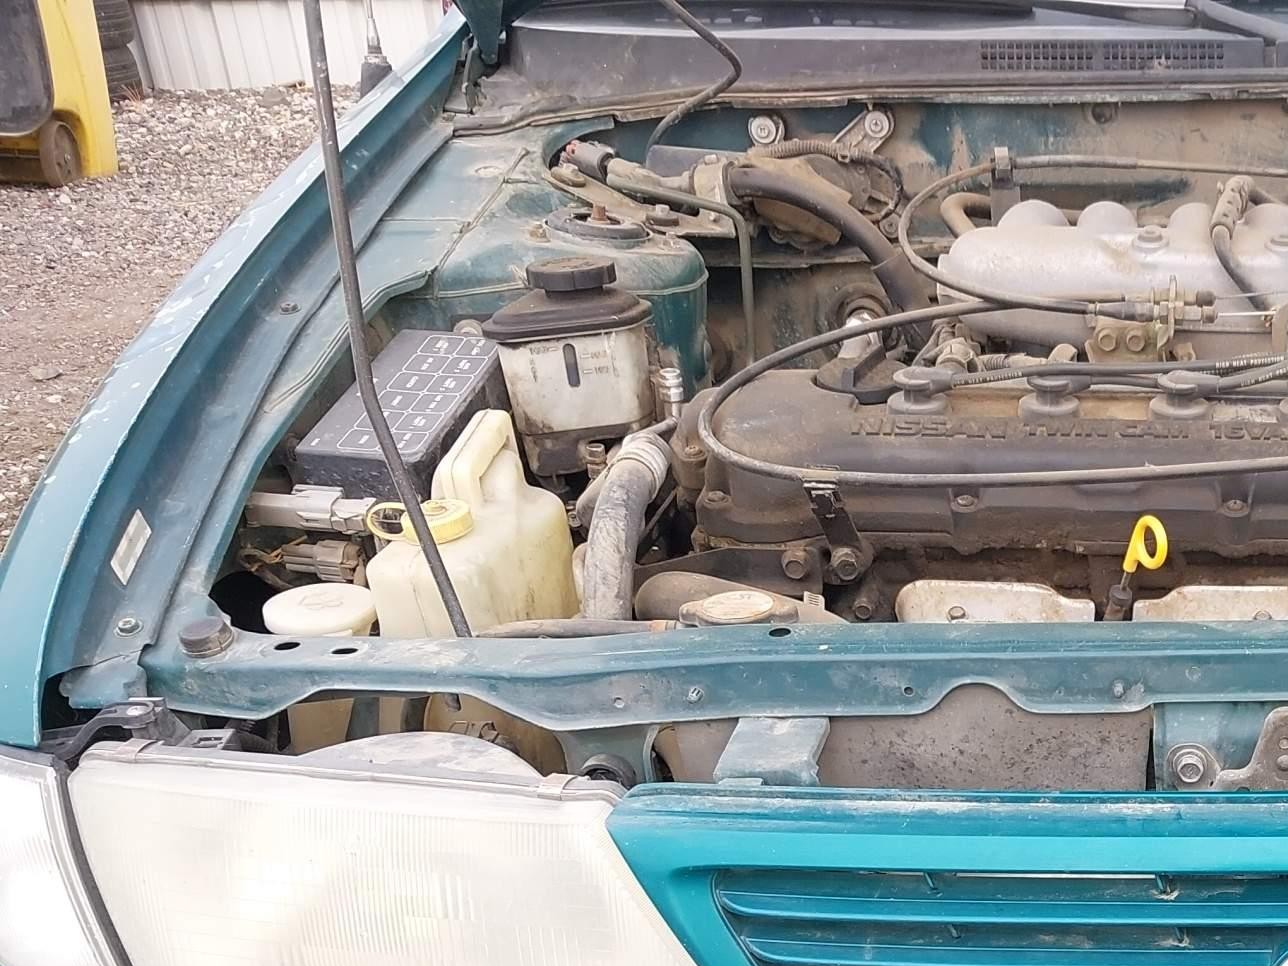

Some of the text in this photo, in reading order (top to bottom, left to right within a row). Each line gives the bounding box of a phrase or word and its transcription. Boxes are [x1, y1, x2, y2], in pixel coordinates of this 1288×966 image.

[850, 417, 1007, 439] NISSAN
[1023, 422, 1108, 438] TWIN
[1118, 425, 1189, 439] CAM
